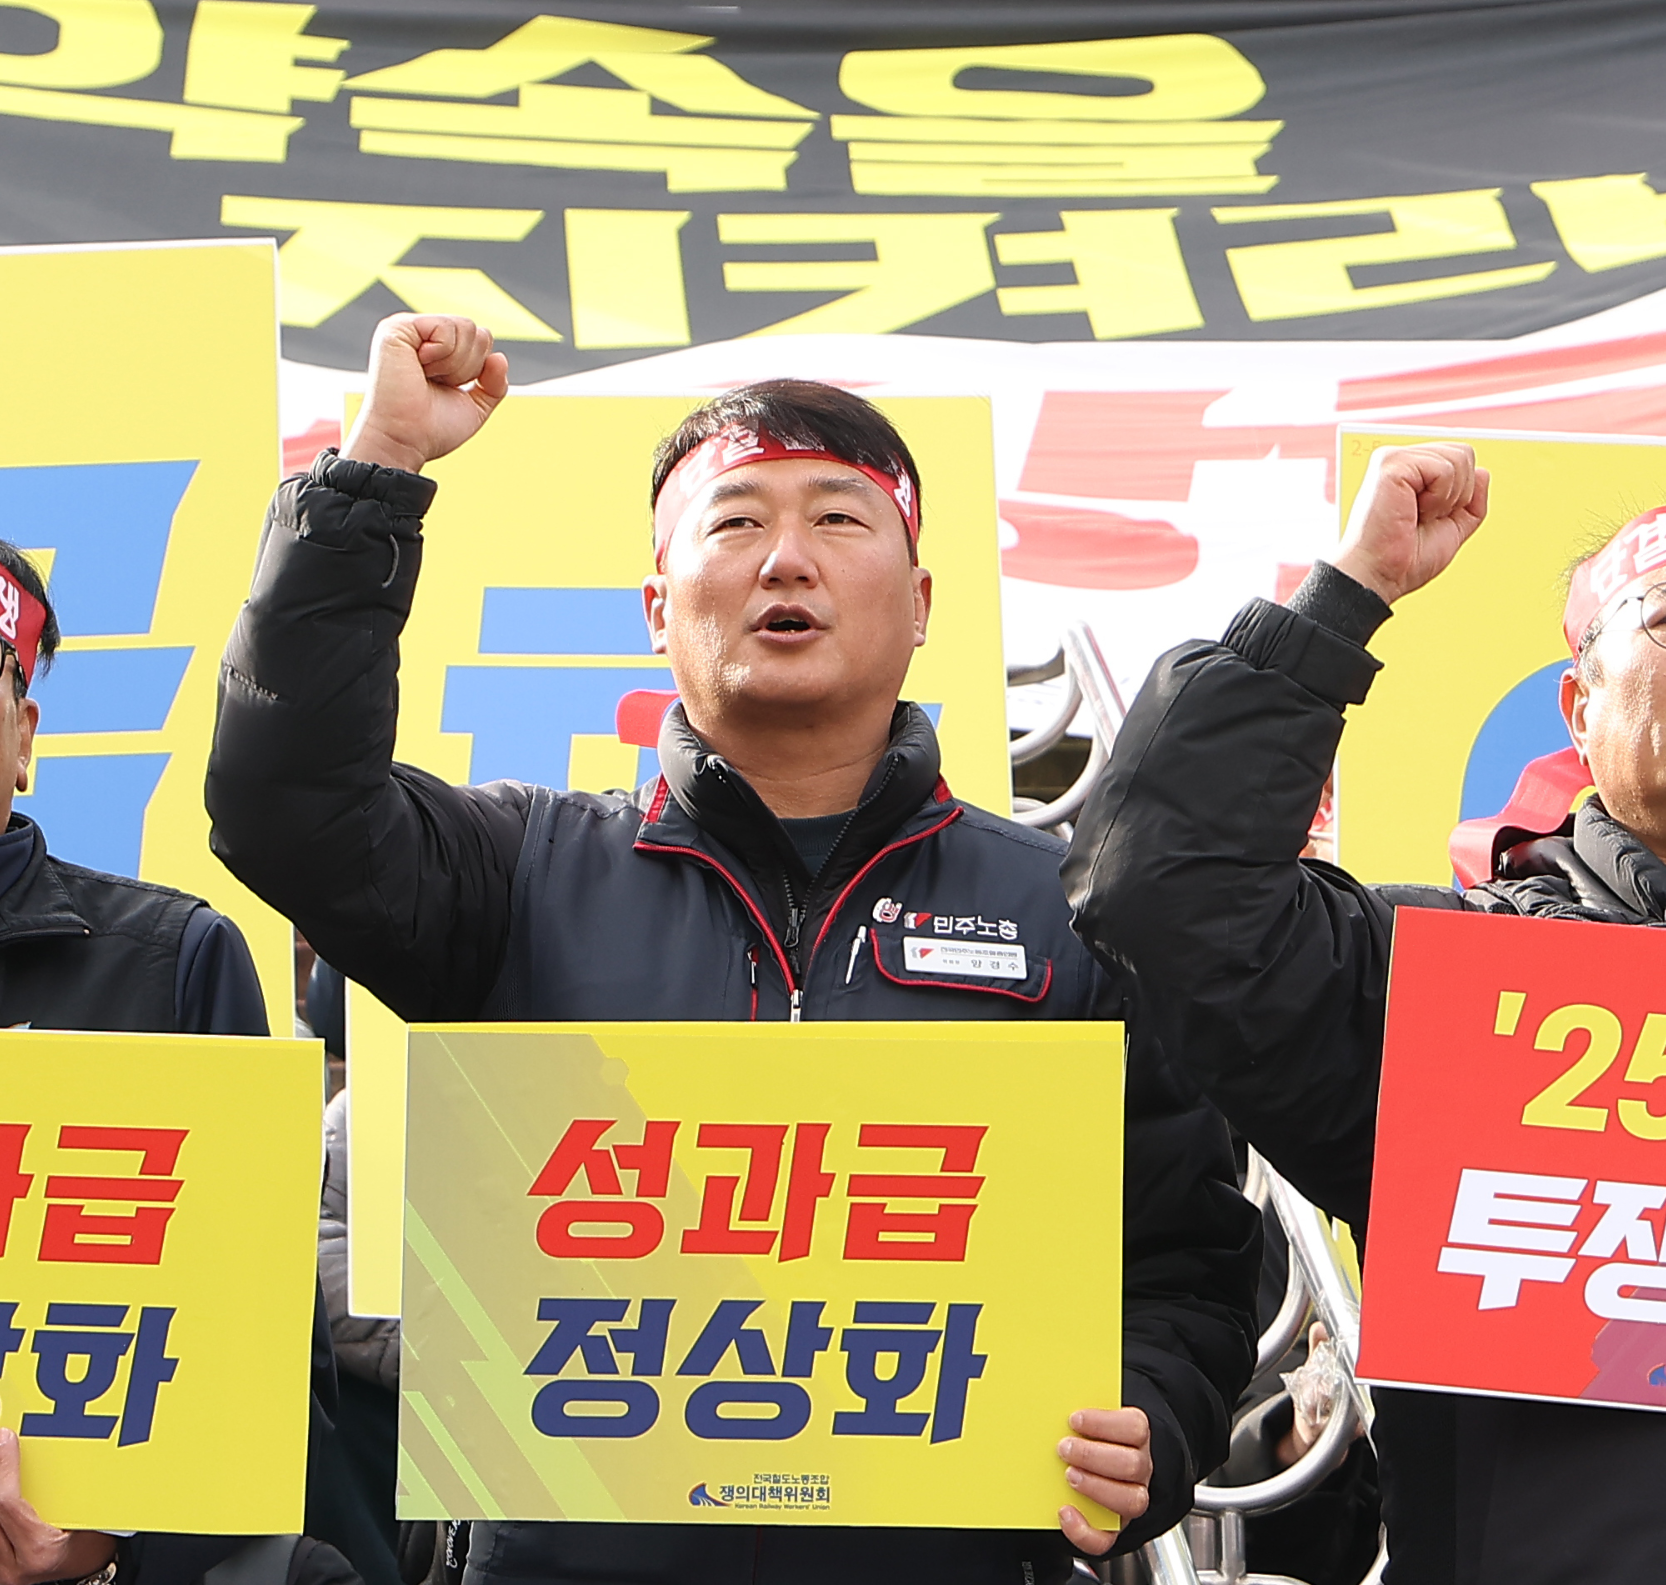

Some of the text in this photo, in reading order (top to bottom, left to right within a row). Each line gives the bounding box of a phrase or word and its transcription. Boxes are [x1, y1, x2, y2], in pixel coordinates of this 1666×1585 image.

[933, 915, 1019, 941] 민주노총
[526, 1118, 990, 1266] 성과급
[524, 1293, 986, 1446] 정상화
[753, 1473, 830, 1485] 전국철도노동조합
[719, 1485, 830, 1504] 쟁의대책위원회
